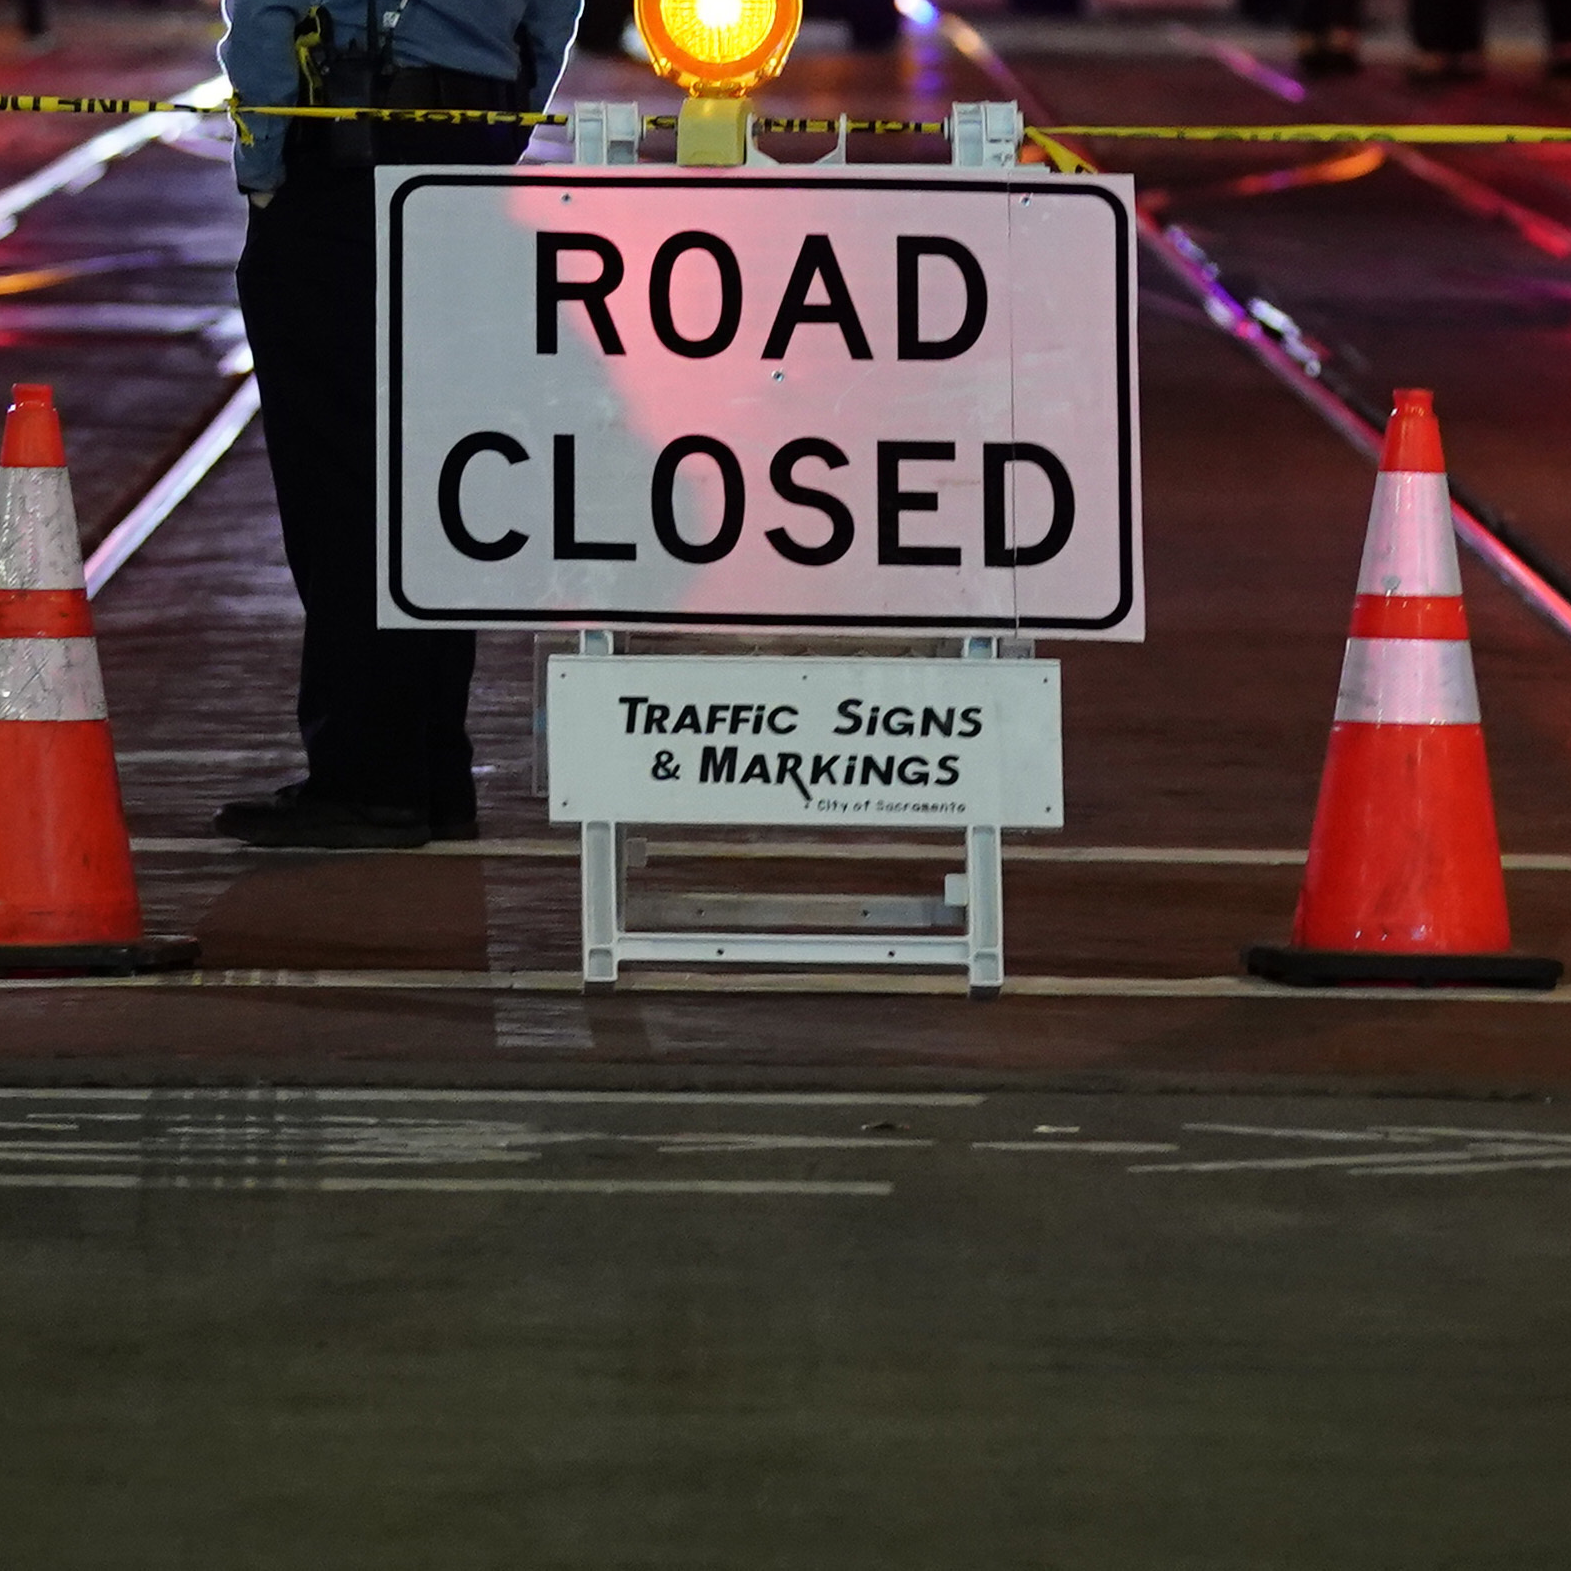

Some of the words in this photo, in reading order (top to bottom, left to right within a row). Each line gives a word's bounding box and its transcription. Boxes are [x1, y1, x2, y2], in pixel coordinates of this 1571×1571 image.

[536, 231, 987, 361] ROAD
[438, 431, 1075, 568] CLOSED
[652, 750, 680, 780] &
[816, 799, 848, 814] City
[853, 799, 871, 813] of
